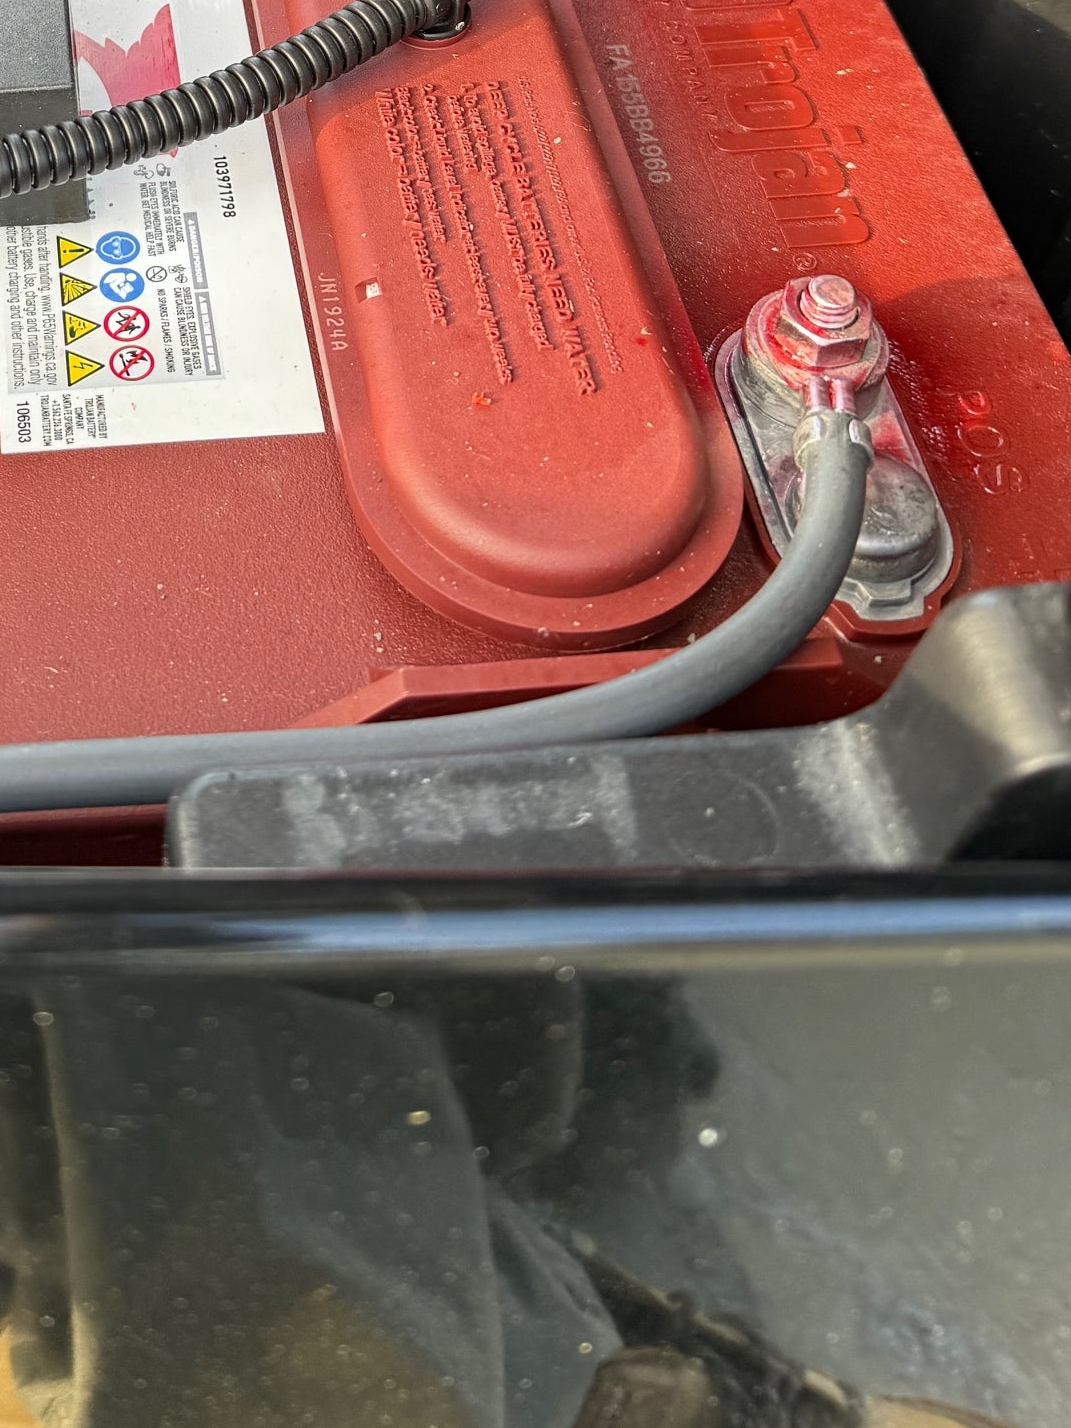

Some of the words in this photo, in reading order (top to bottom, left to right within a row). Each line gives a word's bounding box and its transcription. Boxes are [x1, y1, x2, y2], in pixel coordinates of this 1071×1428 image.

[693, 7, 870, 248] Trojan
[214, 157, 236, 218] 103971798
[317, 272, 352, 354] JN1924A
[16, 402, 32, 443] 106503
